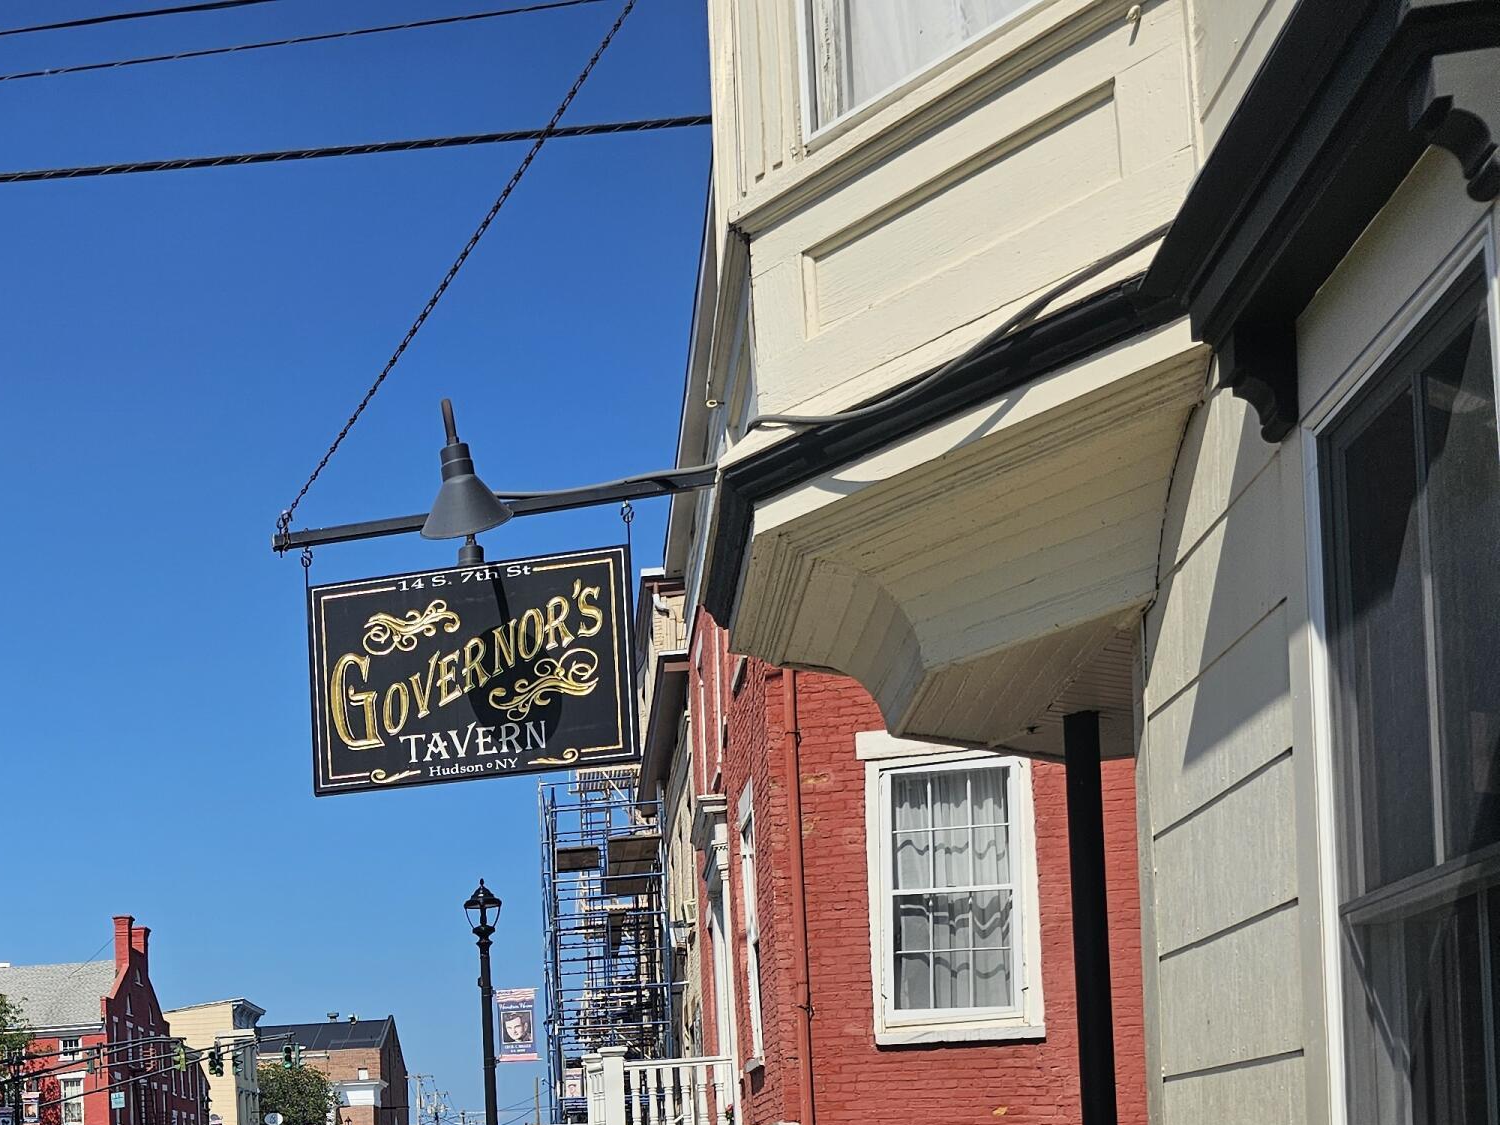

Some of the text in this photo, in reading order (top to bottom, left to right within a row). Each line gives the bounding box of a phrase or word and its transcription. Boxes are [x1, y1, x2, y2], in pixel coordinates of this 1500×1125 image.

[398, 565, 531, 591] 14 S. 7th St
[330, 578, 604, 751] GOVERNOR'S
[399, 720, 546, 763] TAVERN
[429, 757, 518, 776] Hudson NY
